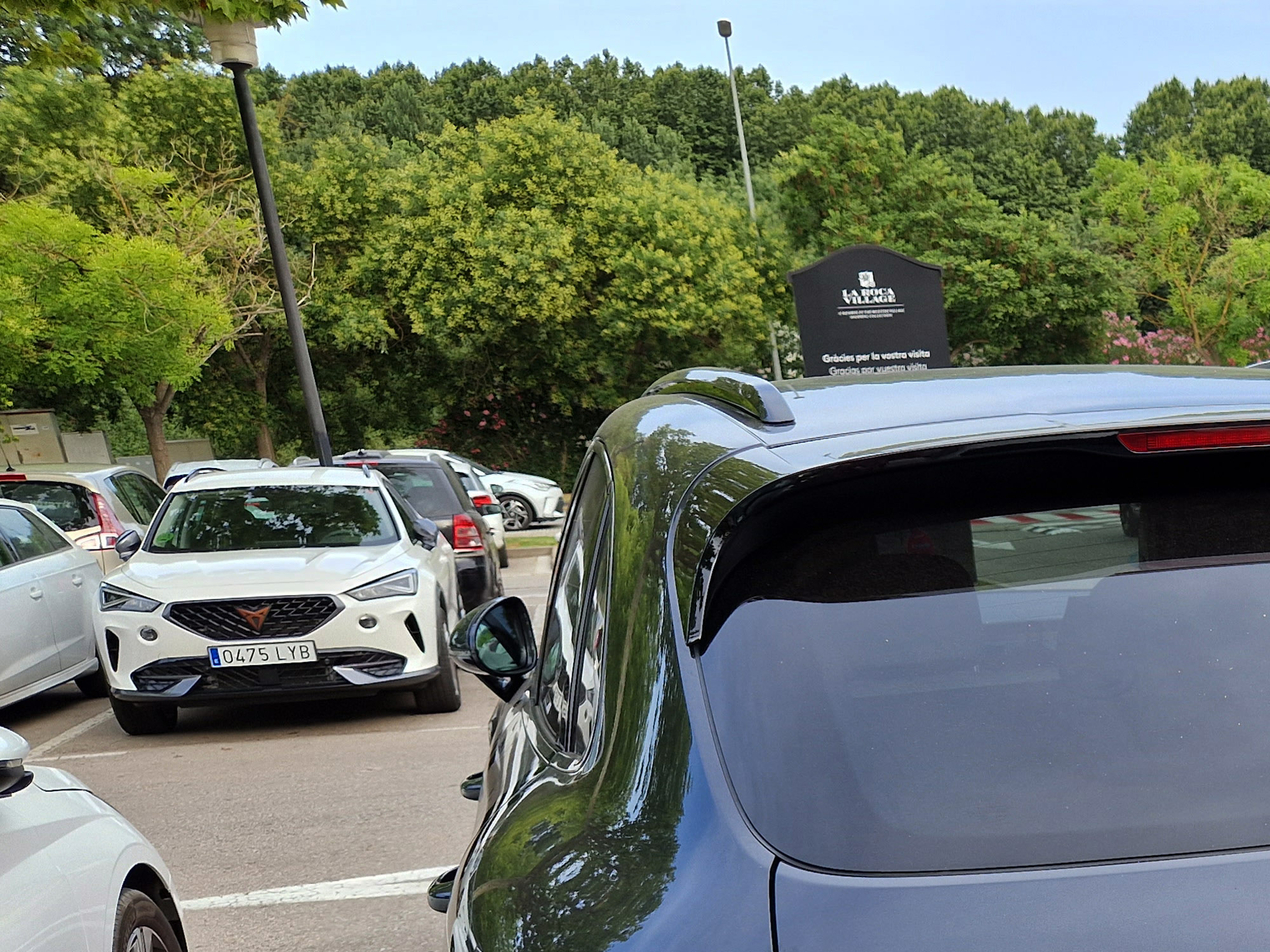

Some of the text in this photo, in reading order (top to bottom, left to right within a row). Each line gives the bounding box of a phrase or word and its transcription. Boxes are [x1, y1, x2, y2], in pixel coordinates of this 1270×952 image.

[842, 287, 895, 298] LA ROCA
[843, 295, 897, 305] VILLAGE
[855, 354, 870, 364] per
[870, 351, 880, 361] la
[880, 351, 907, 360] vostra
[908, 349, 931, 358] visita
[906, 362, 928, 371] visita
[222, 645, 310, 664] 0475 LYB
